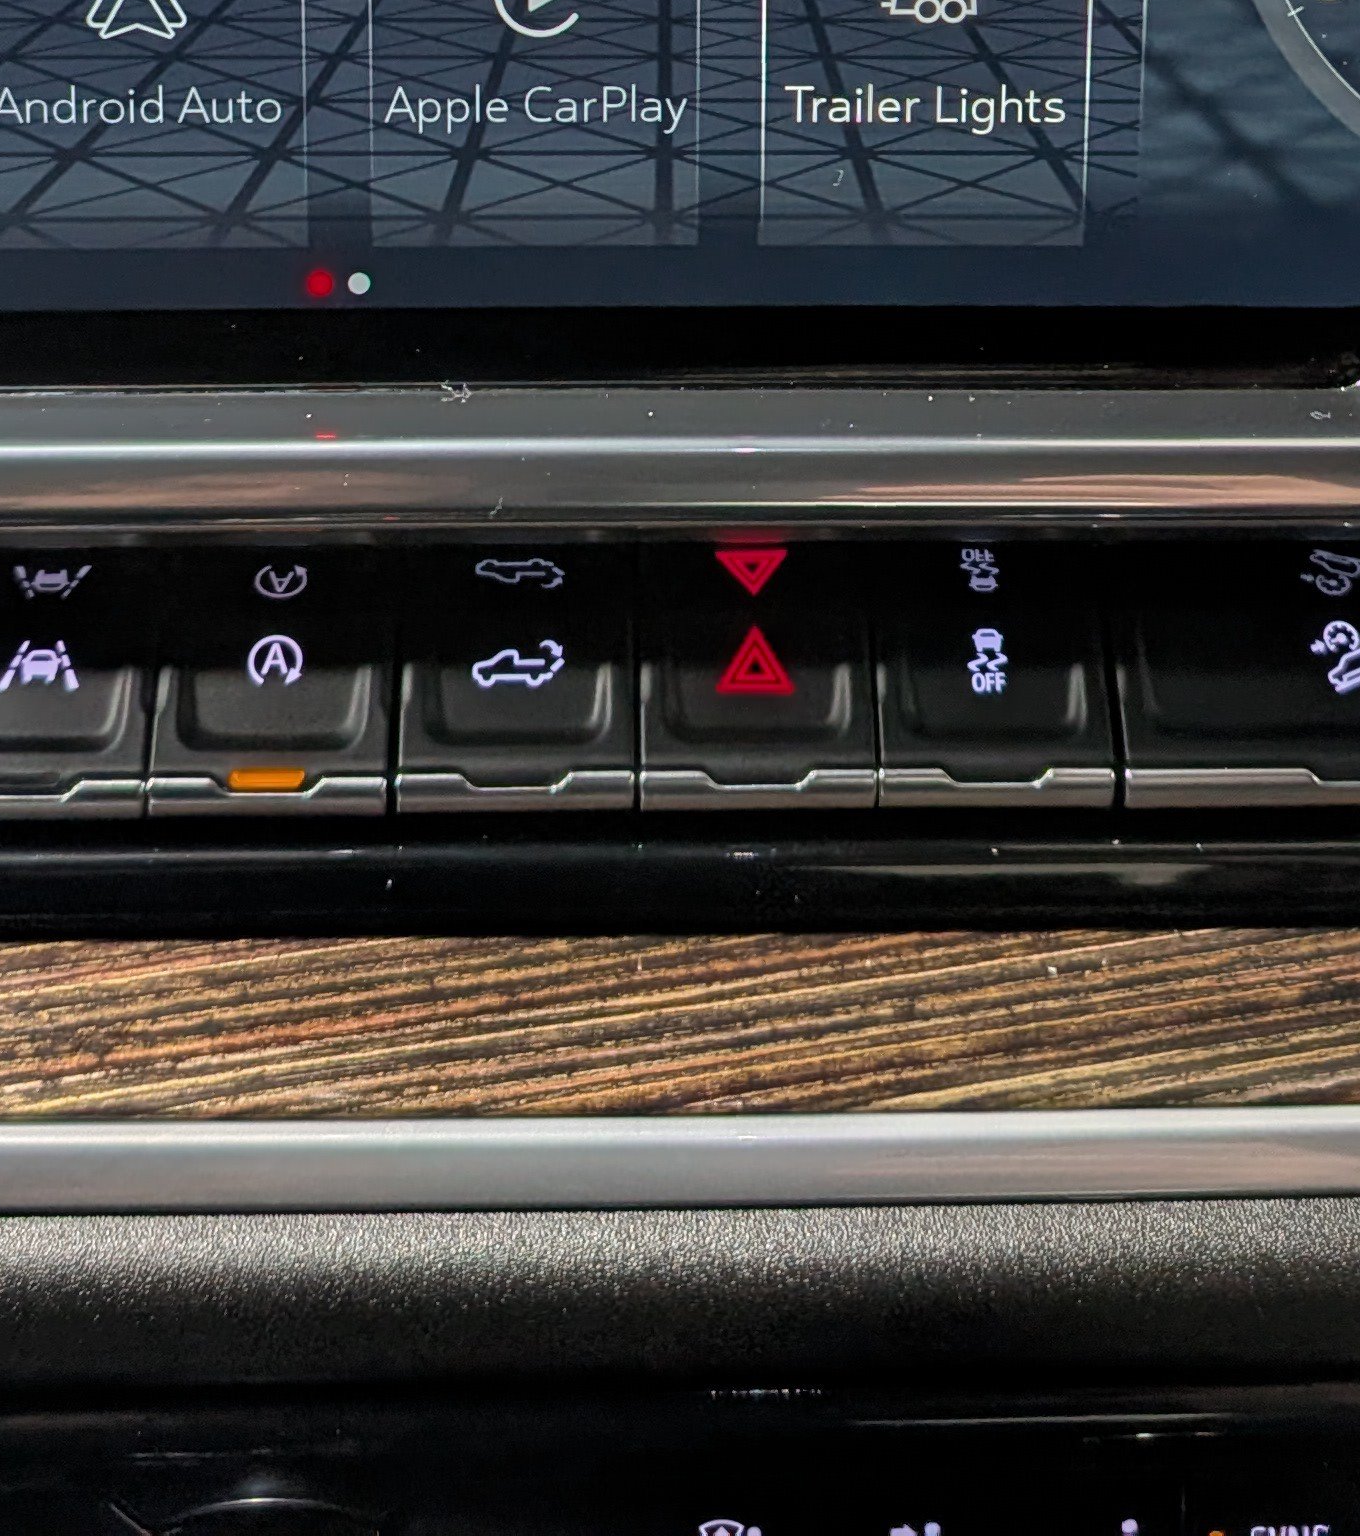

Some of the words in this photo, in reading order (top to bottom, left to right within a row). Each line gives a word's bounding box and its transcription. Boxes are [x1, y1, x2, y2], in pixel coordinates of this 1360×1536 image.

[176, 85, 283, 126] Auto
[383, 82, 509, 135] Apple
[523, 82, 689, 136] CarPlay
[783, 82, 921, 124] Trailer
[935, 82, 1067, 136] Lights
[971, 672, 1007, 694] OFF
